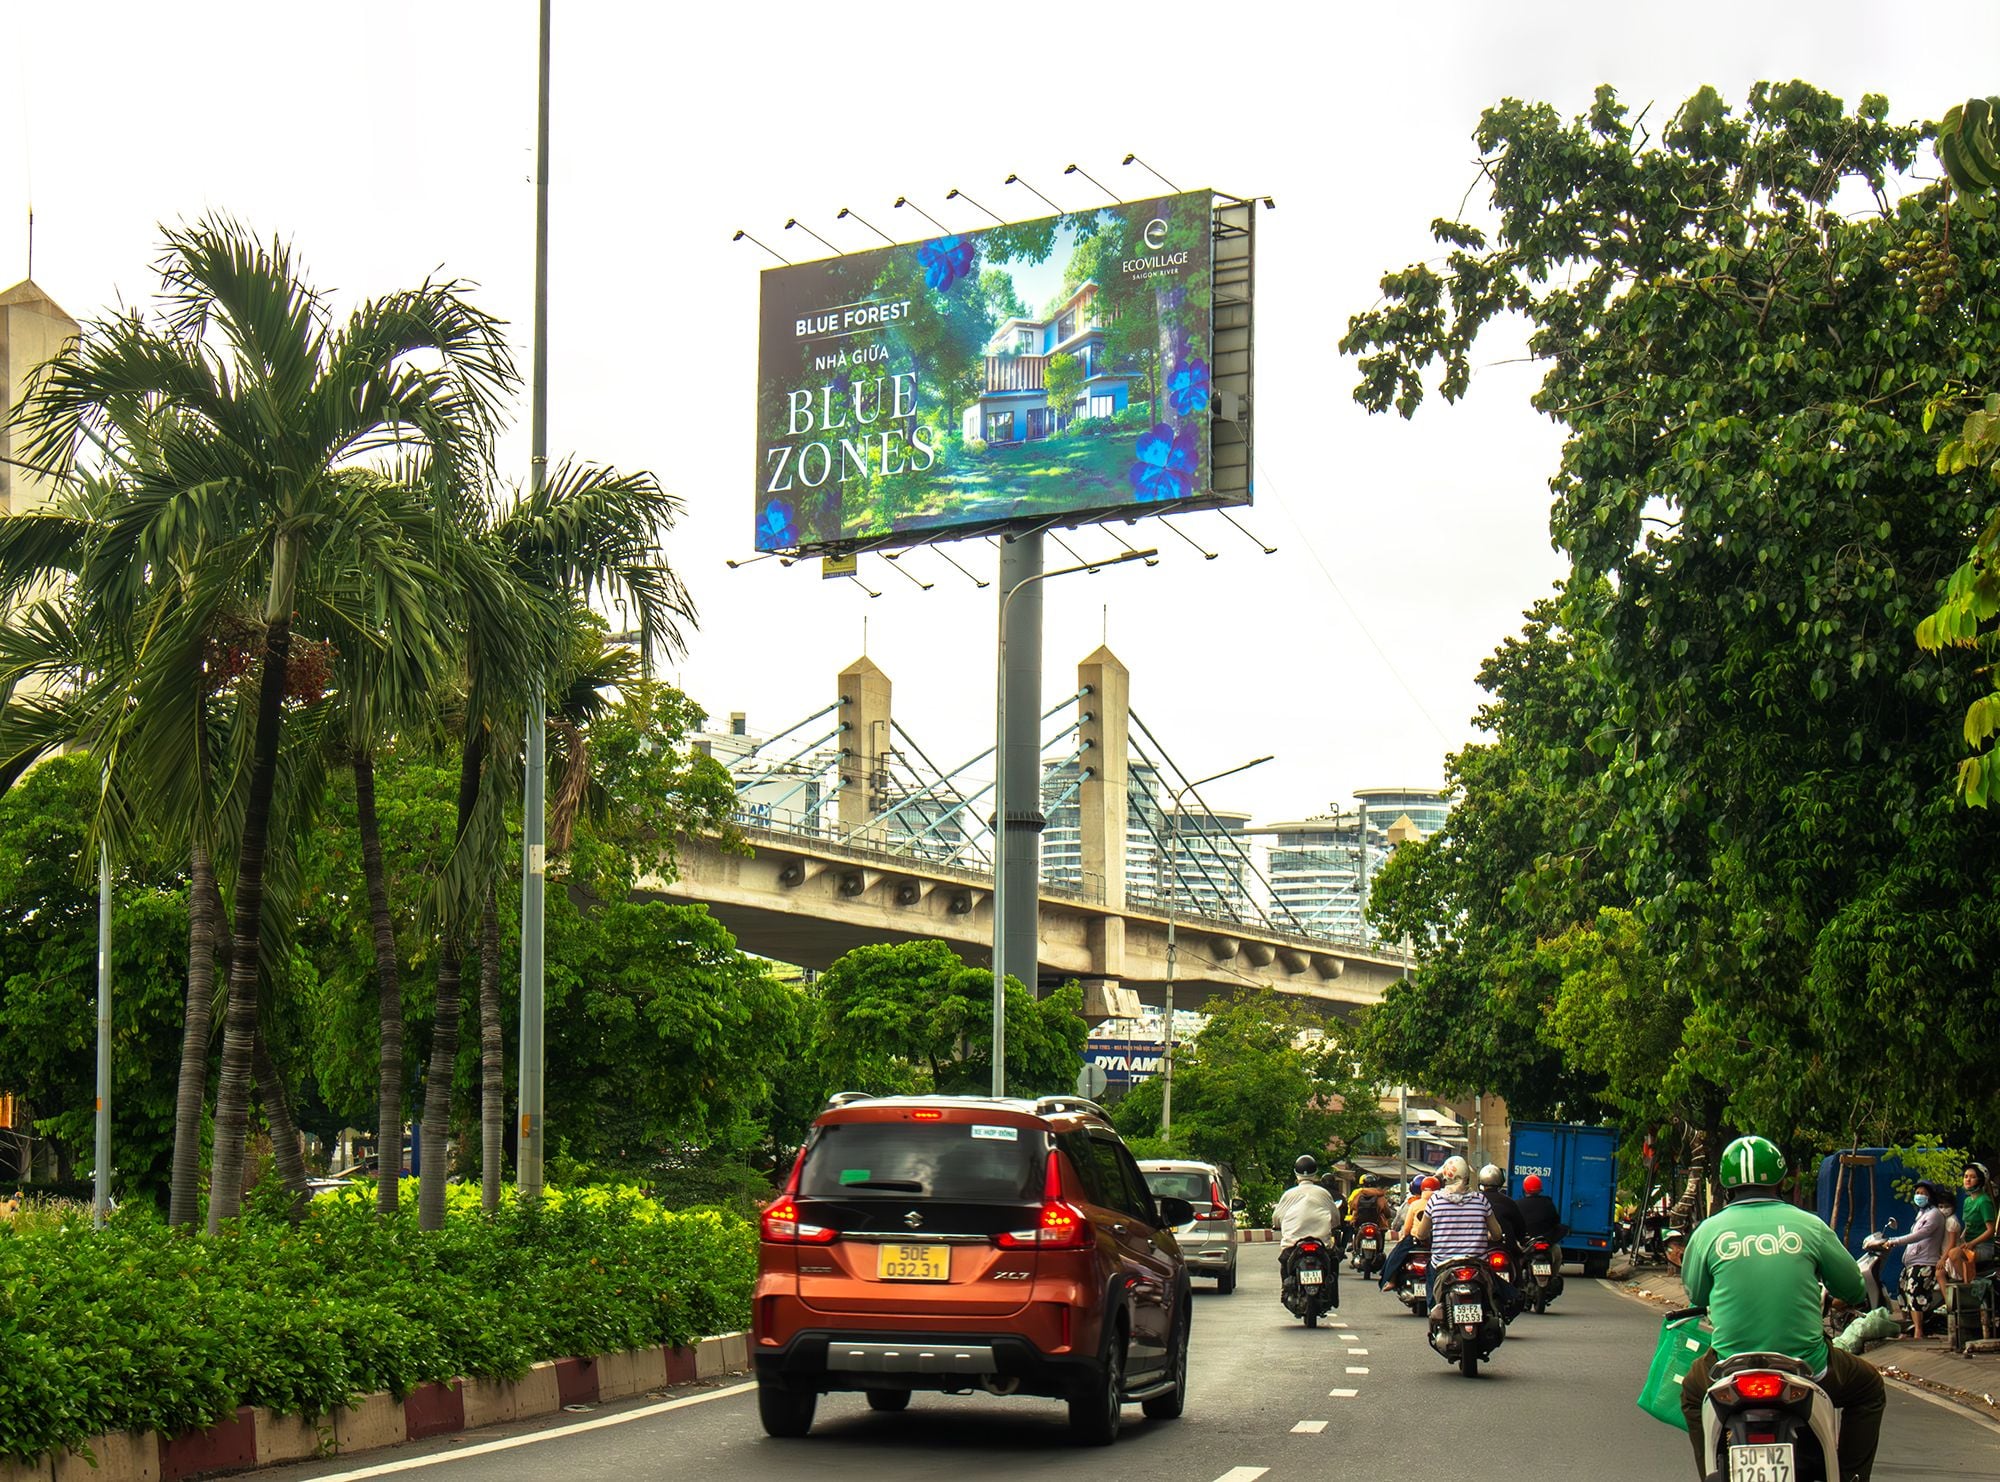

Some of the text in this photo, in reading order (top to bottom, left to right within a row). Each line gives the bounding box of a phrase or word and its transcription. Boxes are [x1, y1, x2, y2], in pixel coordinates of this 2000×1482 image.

[1122, 251, 1188, 273] ECOVILLAGE
[1132, 268, 1179, 281] SAIGON RIVER
[795, 301, 911, 337] BLUE FOREST
[815, 344, 889, 371] NHÀ GIỮA
[785, 371, 918, 436] BLUE
[767, 425, 935, 493] ZONES
[1094, 1055, 1157, 1072] DYNAM
[1715, 1225, 1803, 1261] Grab
[899, 1246, 930, 1261] 50E
[886, 1262, 939, 1278] 032.31
[1739, 1447, 1785, 1466] 50-N2
[1737, 1465, 1789, 1482] 126.17
